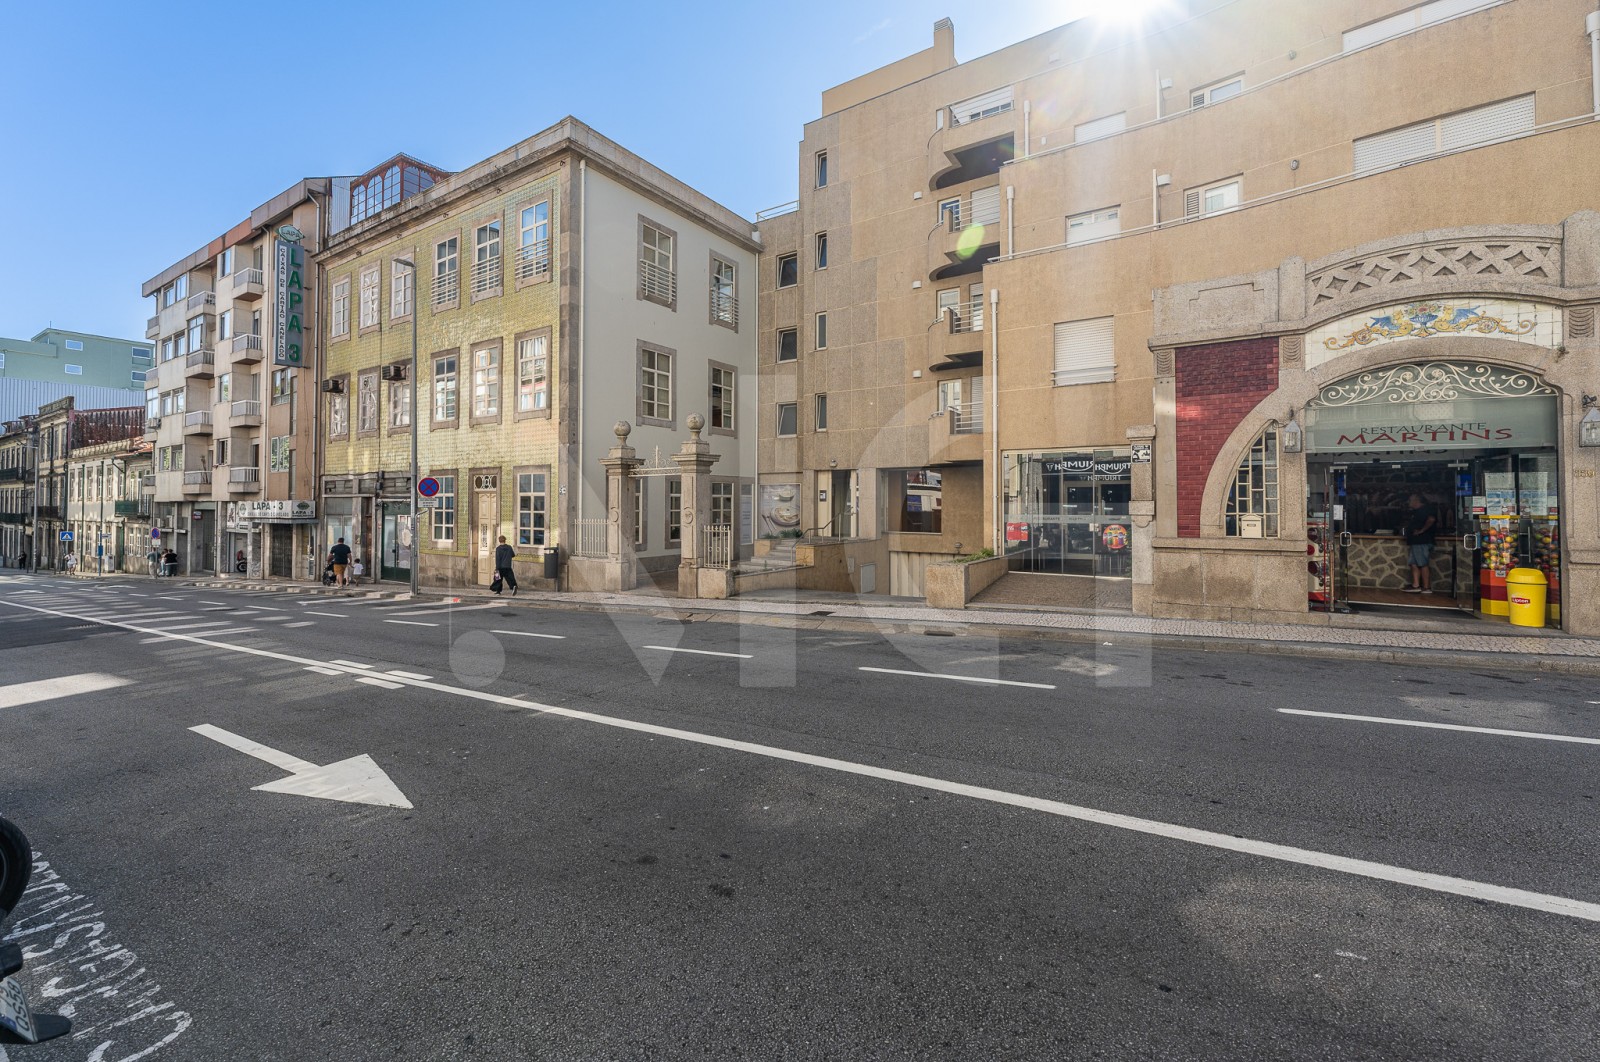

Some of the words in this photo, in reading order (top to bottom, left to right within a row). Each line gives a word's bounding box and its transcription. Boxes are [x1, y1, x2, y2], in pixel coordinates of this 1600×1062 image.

[280, 278, 285, 288] DE
[287, 247, 302, 334] LAPA
[288, 343, 300, 362] 3
[1361, 422, 1487, 435] RESTAURANTE
[1337, 428, 1513, 445] MARTINS
[252, 502, 271, 510] LAPA
[278, 501, 284, 510] 3
